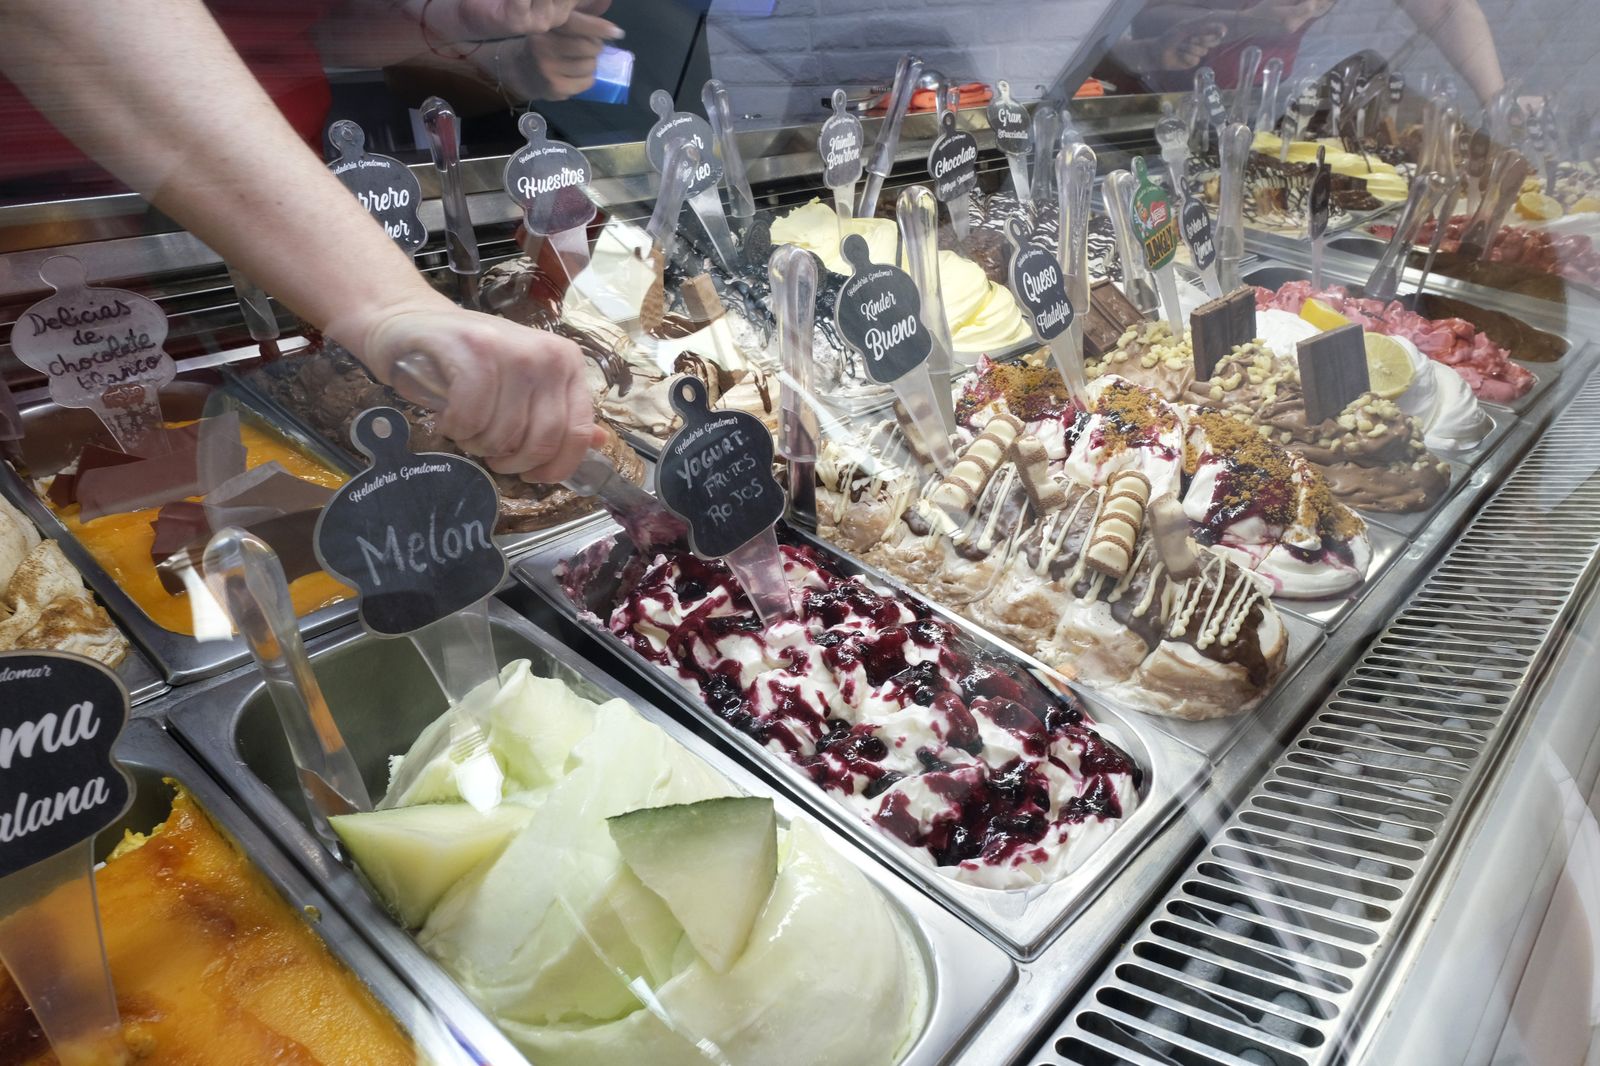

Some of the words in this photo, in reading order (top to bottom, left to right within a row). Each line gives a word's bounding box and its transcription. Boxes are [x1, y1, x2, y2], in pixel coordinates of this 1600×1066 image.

[998, 108, 1023, 127] Gran
[826, 147, 860, 170] Bourbon
[935, 146, 977, 178] Chocolate
[517, 167, 584, 199] Huesitos
[358, 187, 410, 212] rrero
[384, 220, 410, 239] her
[1022, 265, 1058, 303] Queso
[29, 299, 132, 337] Delicias
[861, 291, 897, 321] Kinder
[72, 329, 102, 346] de
[865, 314, 917, 361] Bueno
[674, 428, 704, 456] Heladeria
[704, 416, 739, 434] Gondomar
[349, 472, 398, 503] Heladeria
[400, 462, 452, 480] Gondomar
[356, 498, 493, 586] Melón
[0, 664, 51, 682] domar
[0, 701, 101, 769] ma
[0, 777, 110, 843] alana
